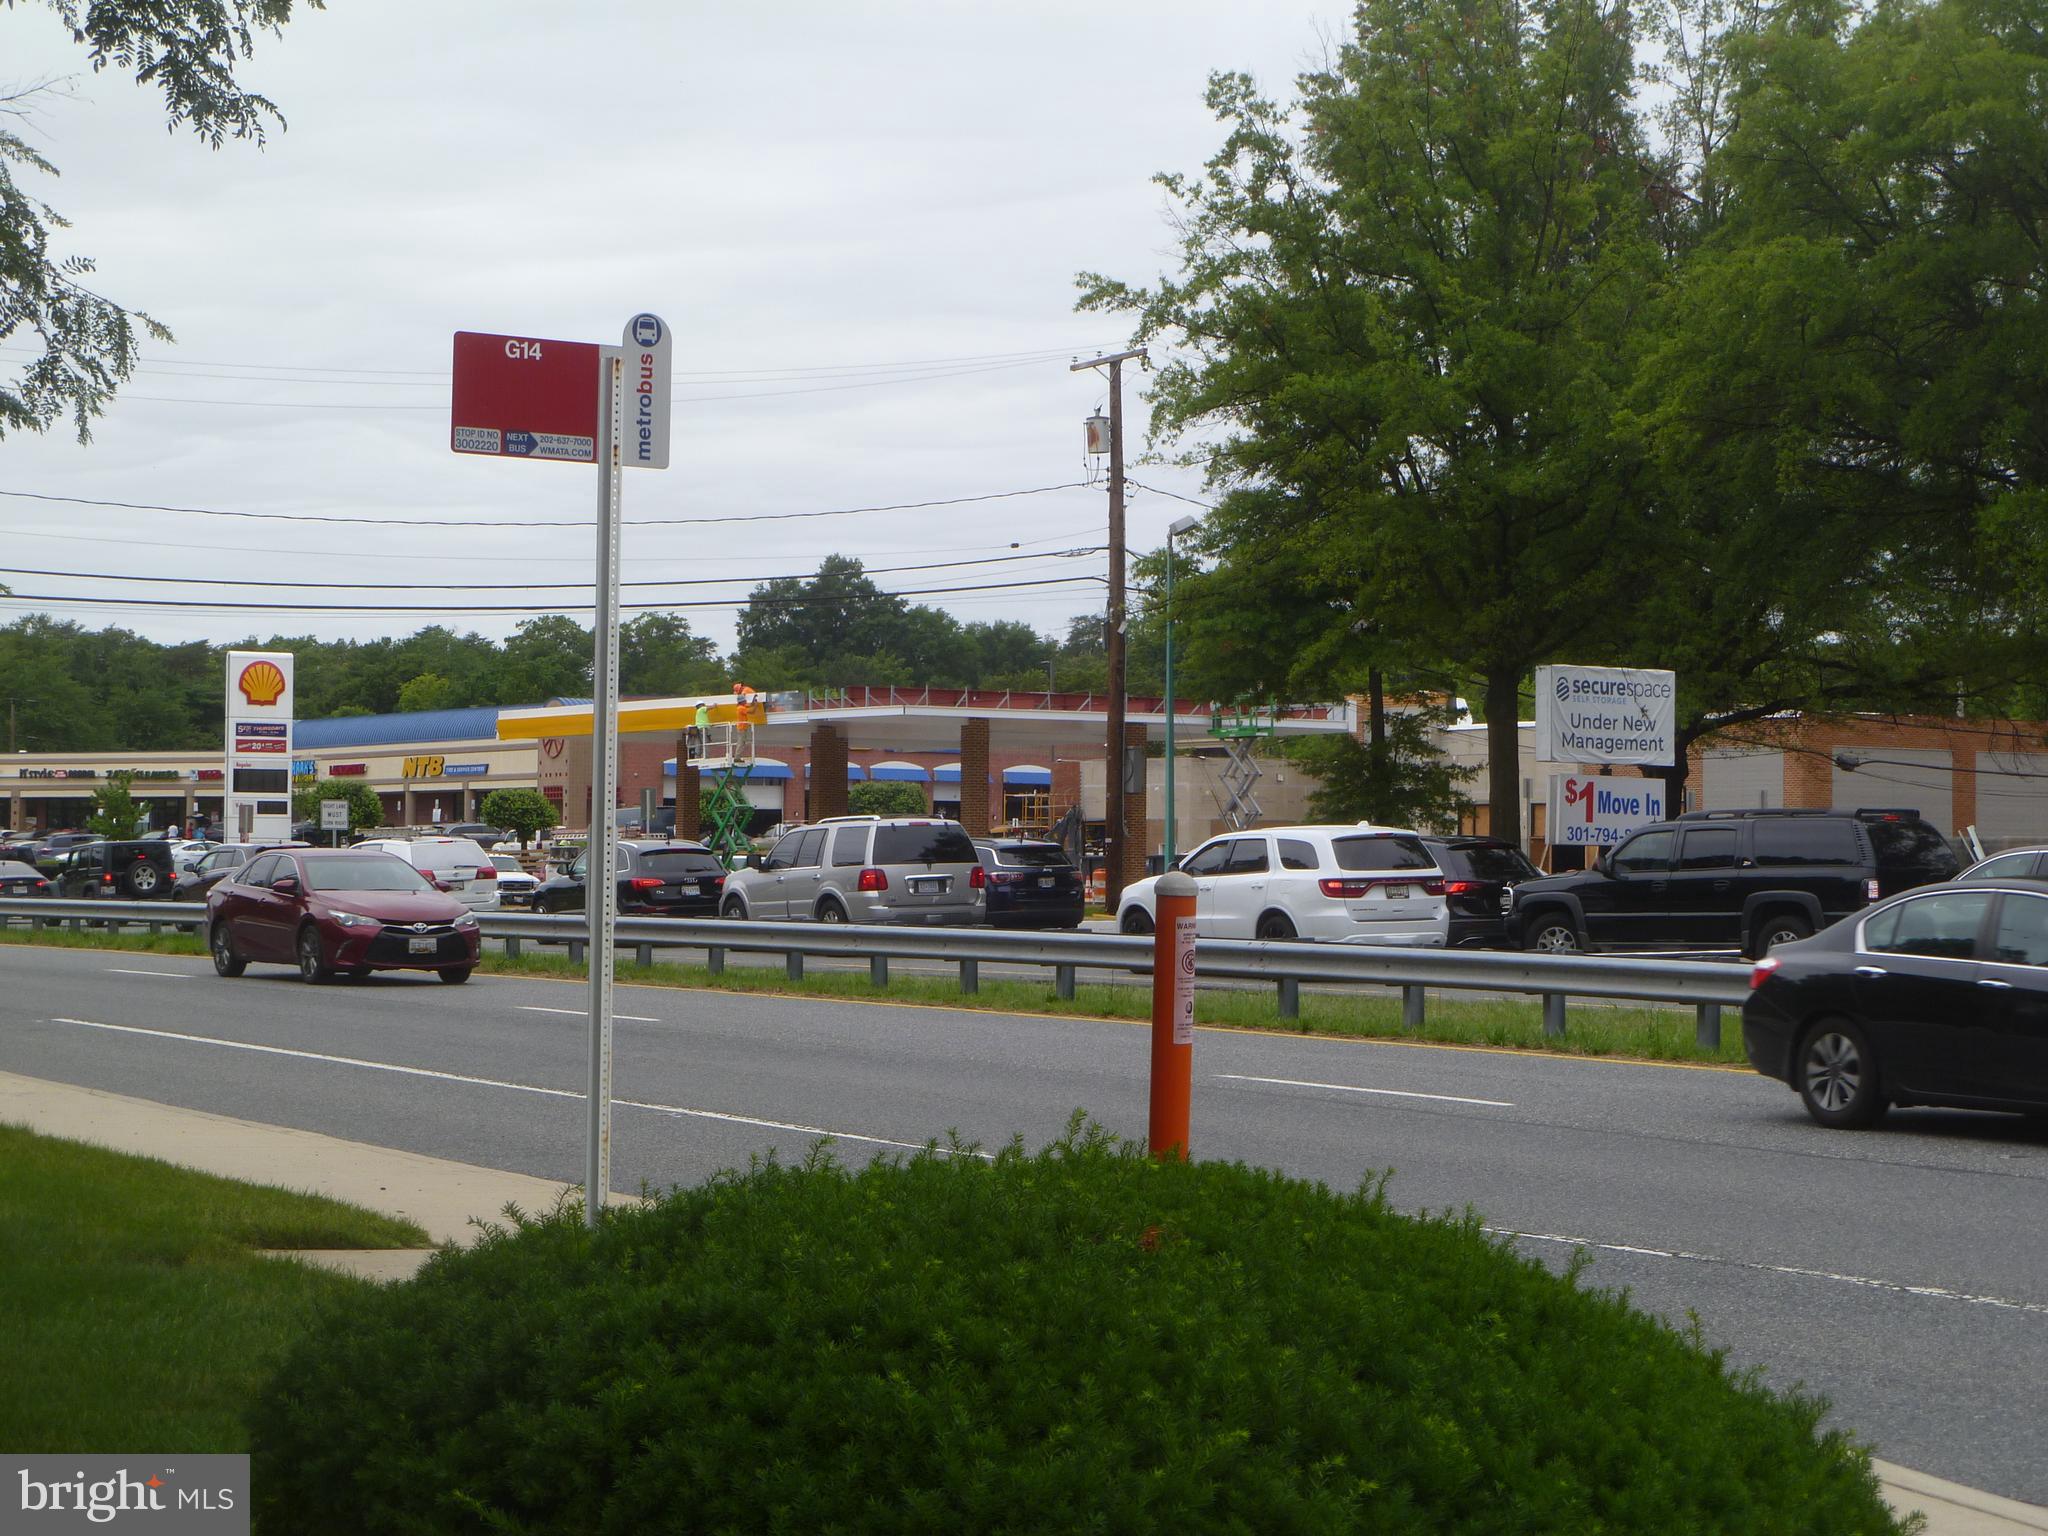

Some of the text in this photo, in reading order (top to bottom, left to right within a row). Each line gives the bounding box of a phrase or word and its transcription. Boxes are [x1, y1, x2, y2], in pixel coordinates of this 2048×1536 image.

[505, 340, 542, 360] G14
[636, 353, 653, 461] metrobus
[455, 428, 476, 437] STOP
[477, 430, 485, 438] ID
[506, 433, 529, 442] NEXT
[540, 435, 592, 446] 202-637-7000
[455, 439, 499, 451] 3002220
[508, 444, 527, 453] BUS
[540, 447, 592, 457] WMATA.COM
[1572, 680, 1671, 698] securespace
[1572, 695, 1627, 705] SELF STORAGE
[1570, 713, 1656, 732] Under New
[1561, 732, 1664, 753] Management
[402, 755, 444, 777] NTB
[1565, 777, 1660, 823] $1 Move In
